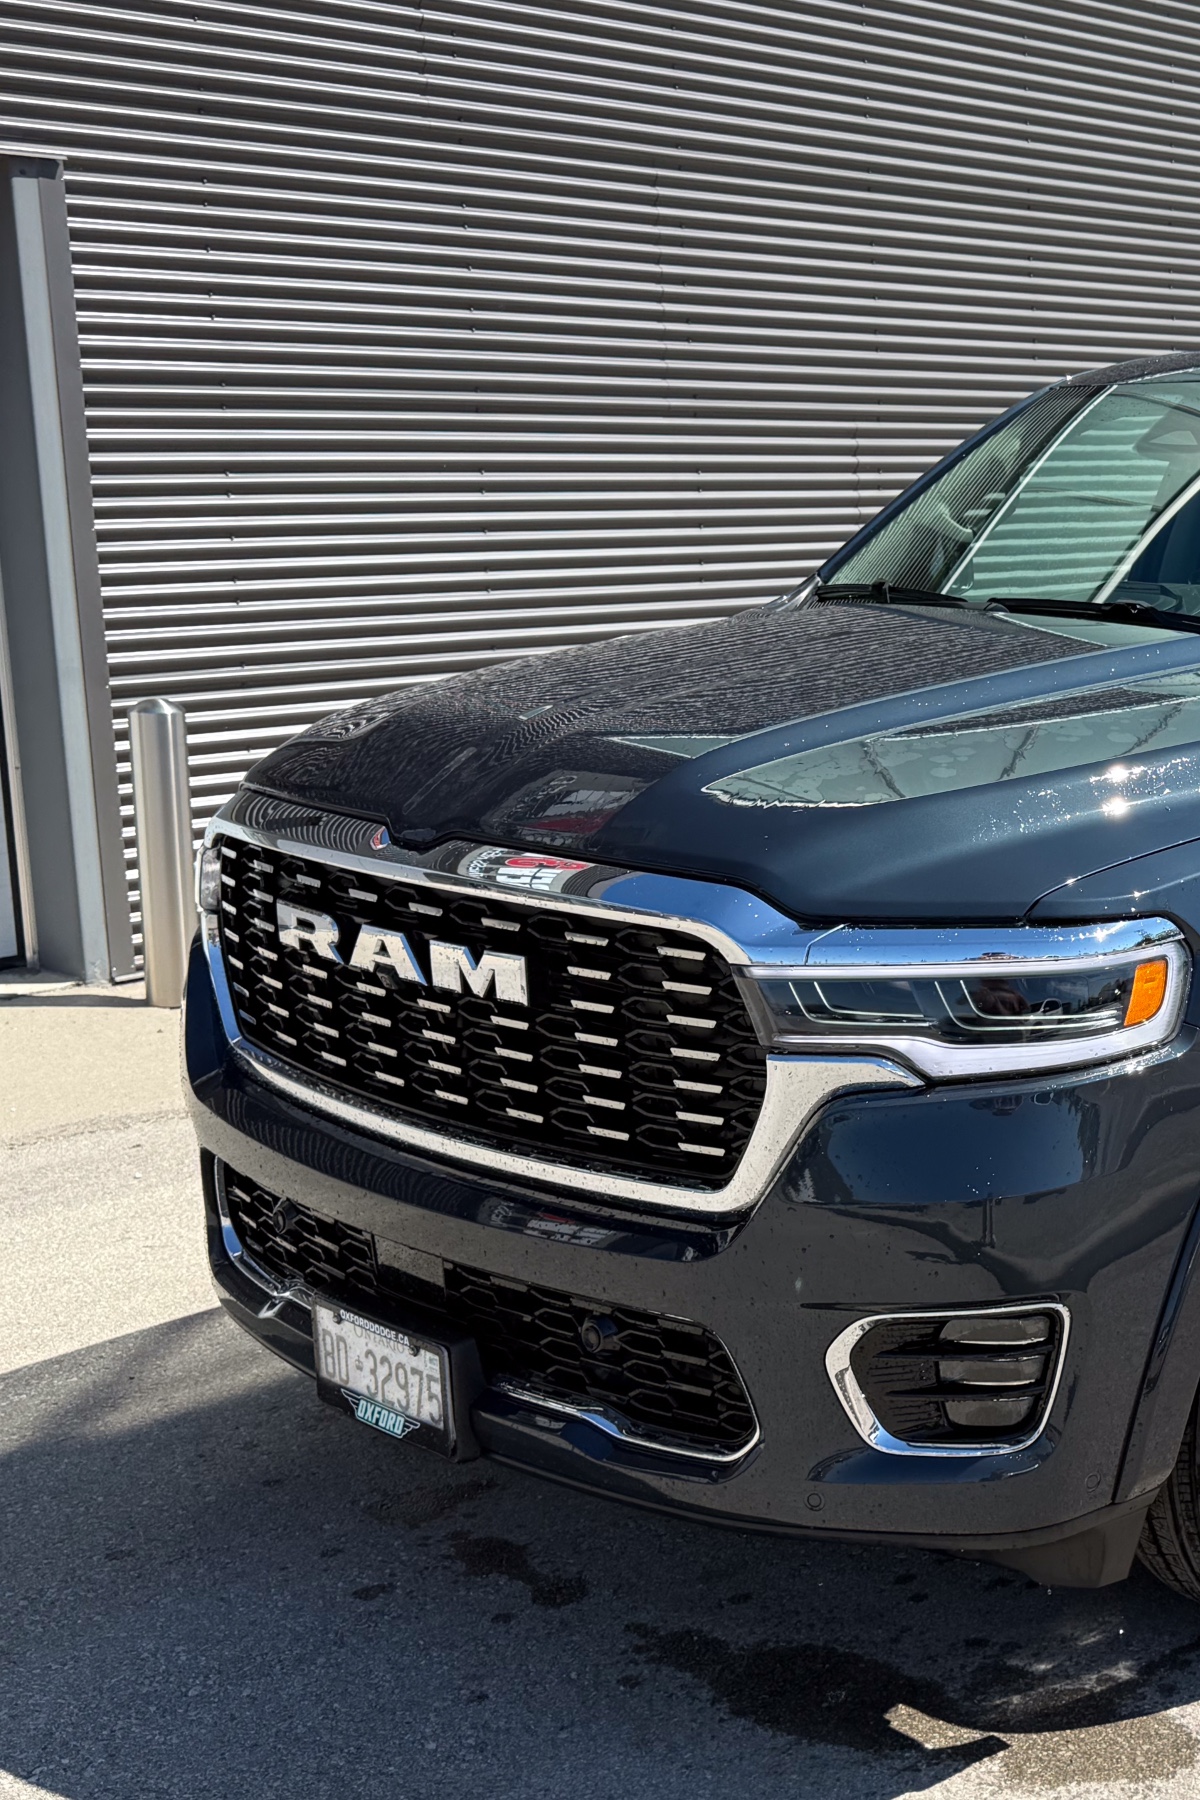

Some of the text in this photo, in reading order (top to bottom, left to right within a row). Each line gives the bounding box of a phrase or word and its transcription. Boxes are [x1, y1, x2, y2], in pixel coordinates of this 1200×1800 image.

[276, 899, 529, 1007] RAM
[340, 1309, 410, 1346] OXFORDDODGE.CA
[321, 1328, 443, 1425] BD 32975
[357, 1399, 406, 1436] OXFORD
